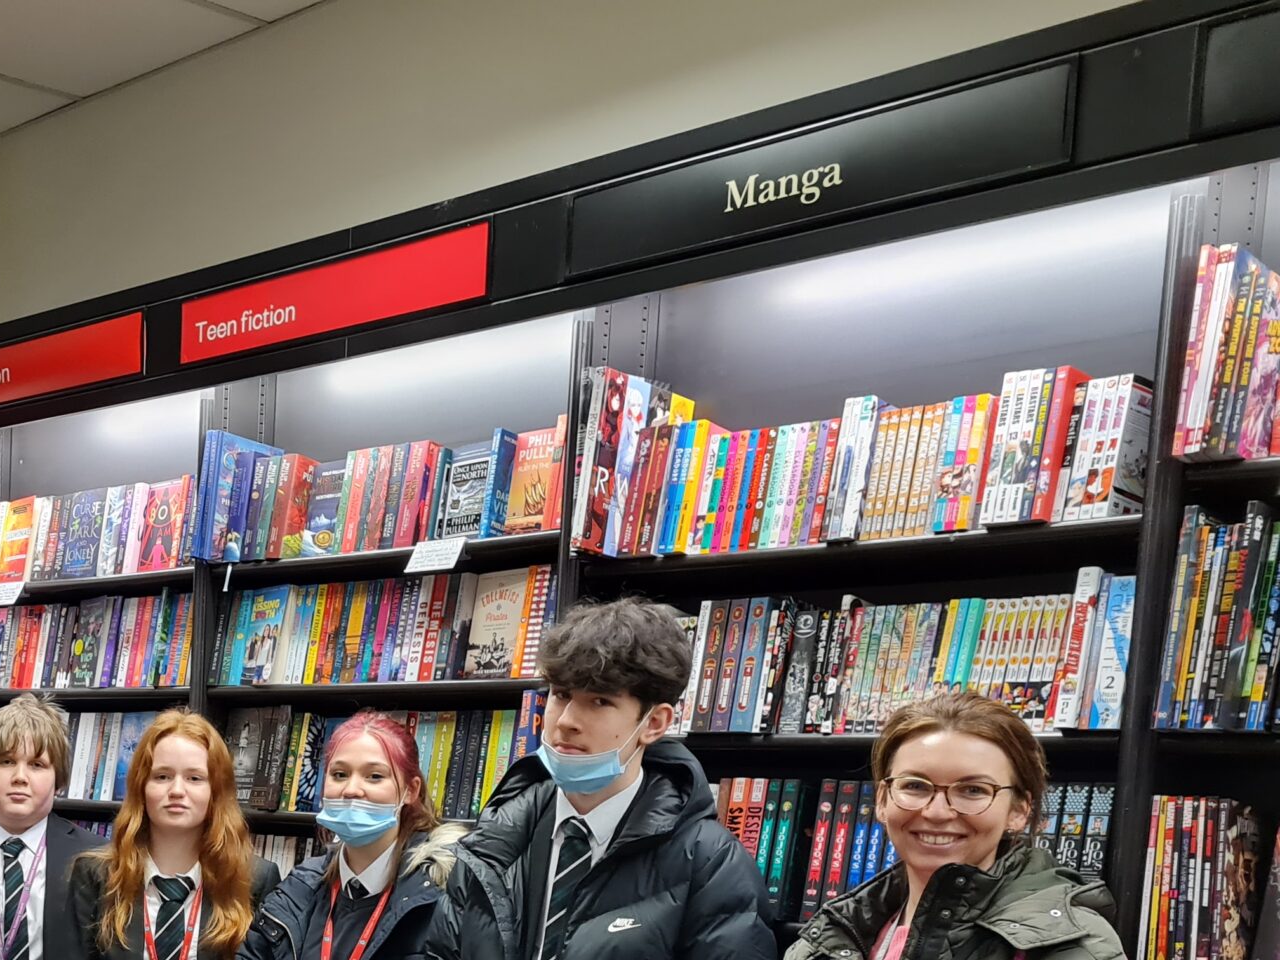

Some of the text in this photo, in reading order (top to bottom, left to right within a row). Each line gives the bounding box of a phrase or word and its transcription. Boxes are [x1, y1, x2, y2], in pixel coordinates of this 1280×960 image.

[724, 162, 843, 213] Manga
[195, 303, 296, 344] Teen fiction
[461, 469, 487, 481] NORTH
[445, 523, 480, 535] PULLMAN
[451, 514, 475, 525] PHILIP
[69, 526, 99, 541] DARK
[65, 542, 97, 564] LONELY
[481, 589, 520, 608] EDELWEISS
[409, 602, 428, 664] GENESIS
